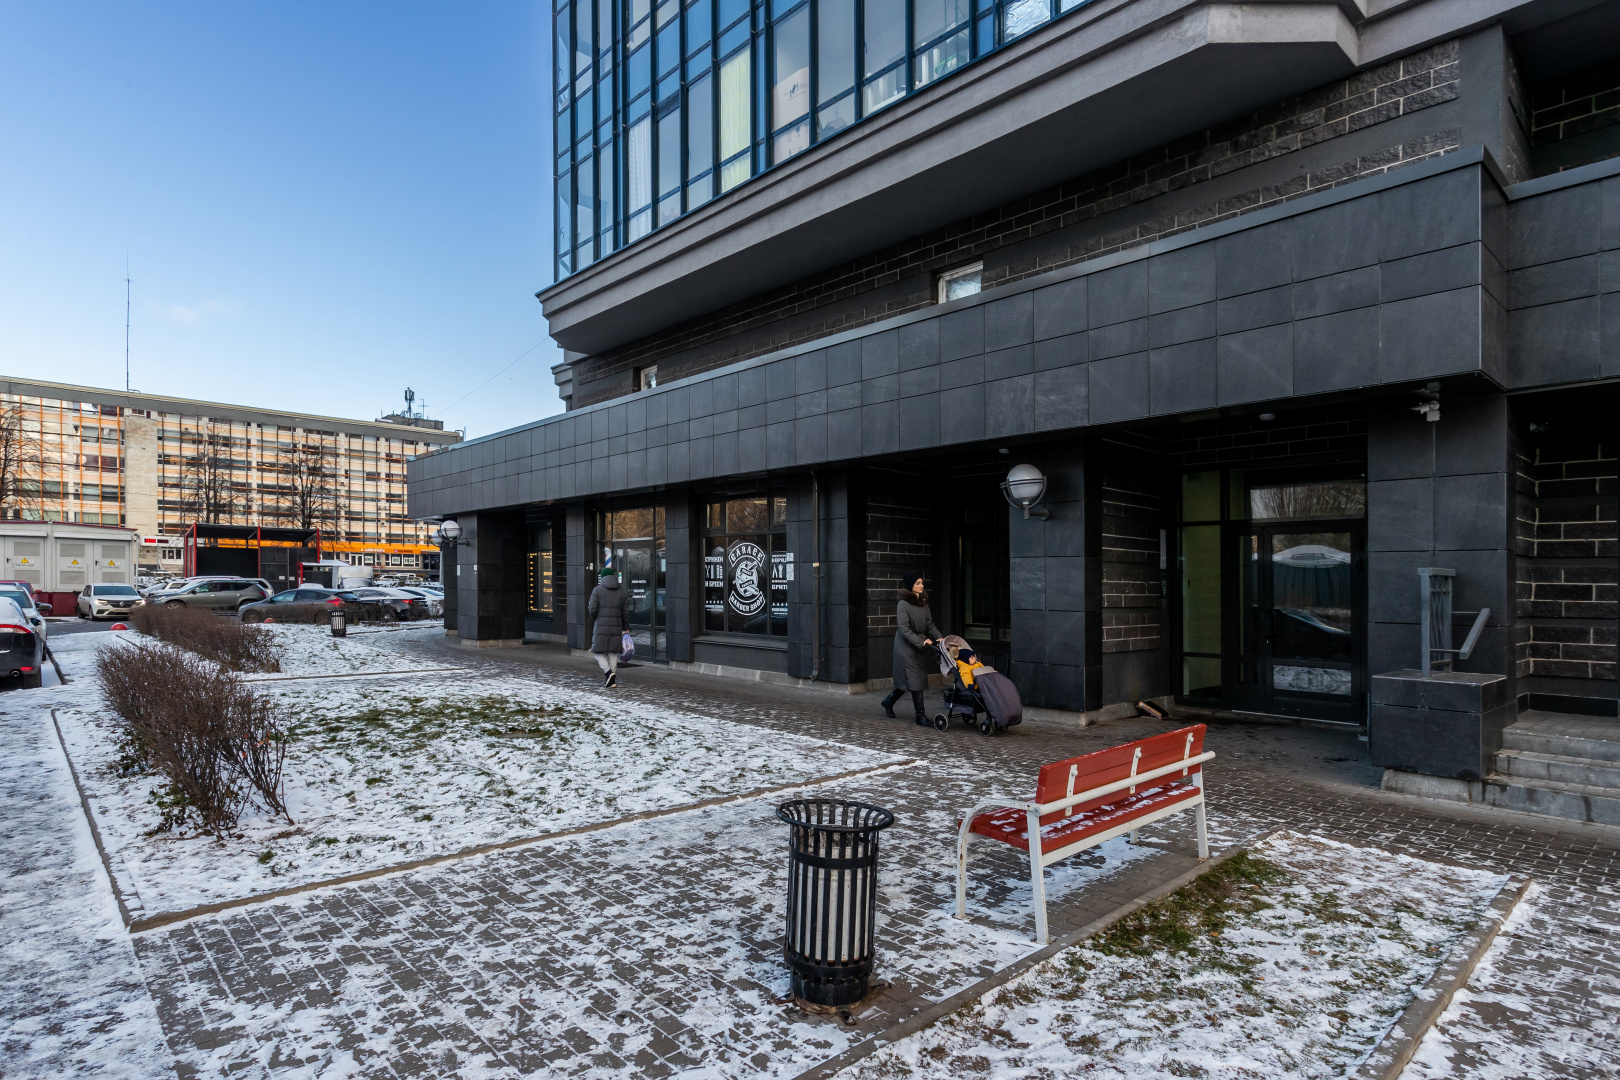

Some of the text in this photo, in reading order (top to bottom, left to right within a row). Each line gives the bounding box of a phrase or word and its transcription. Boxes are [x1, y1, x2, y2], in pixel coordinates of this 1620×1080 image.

[731, 546, 763, 562] GARAGE
[730, 596, 763, 611] BARBER SHOP
